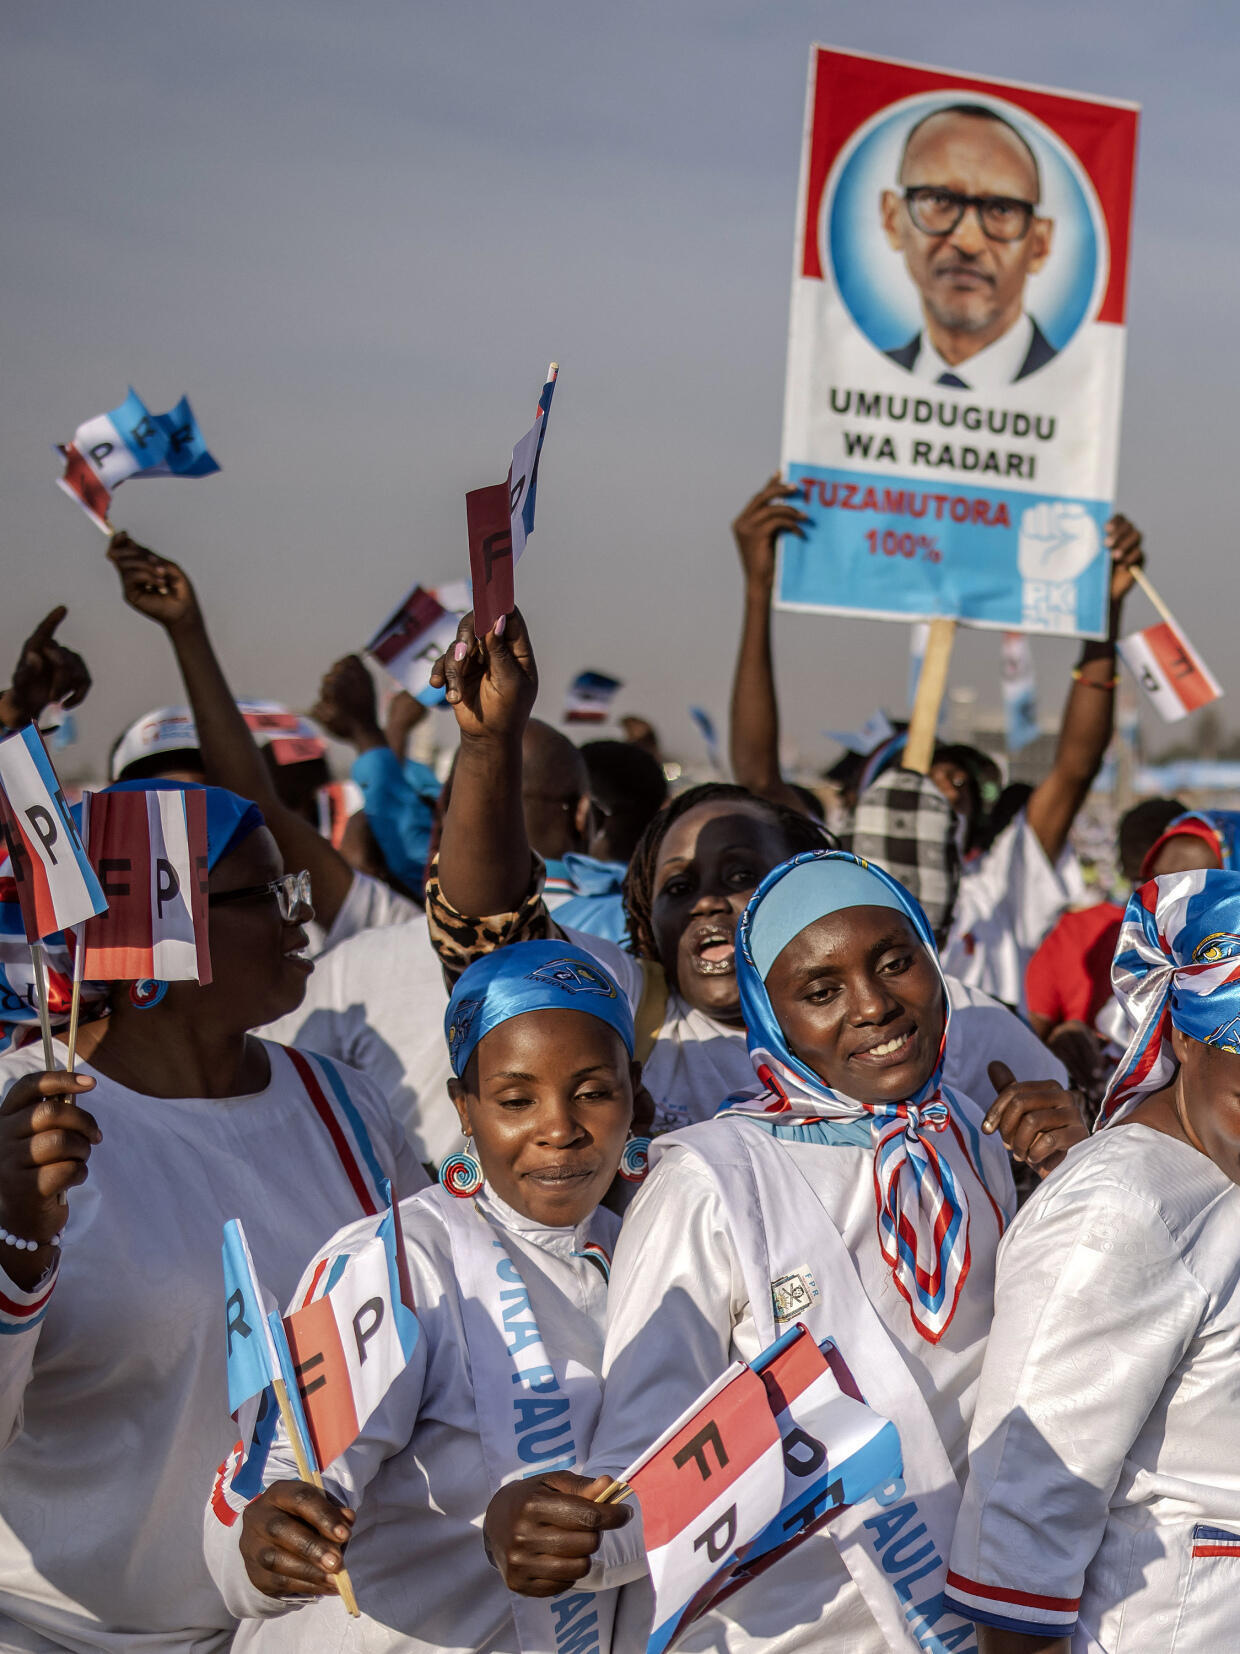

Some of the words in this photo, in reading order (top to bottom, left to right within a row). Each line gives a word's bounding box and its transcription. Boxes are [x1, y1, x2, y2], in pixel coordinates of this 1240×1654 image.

[829, 387, 1057, 442] UMUDUGUDU
[844, 431, 897, 463] WA
[911, 440, 1036, 480] RADARI
[800, 476, 1012, 528] TUZAMUTORA
[865, 528, 942, 564] 100%
[855, 1477, 944, 1605] PAUL
